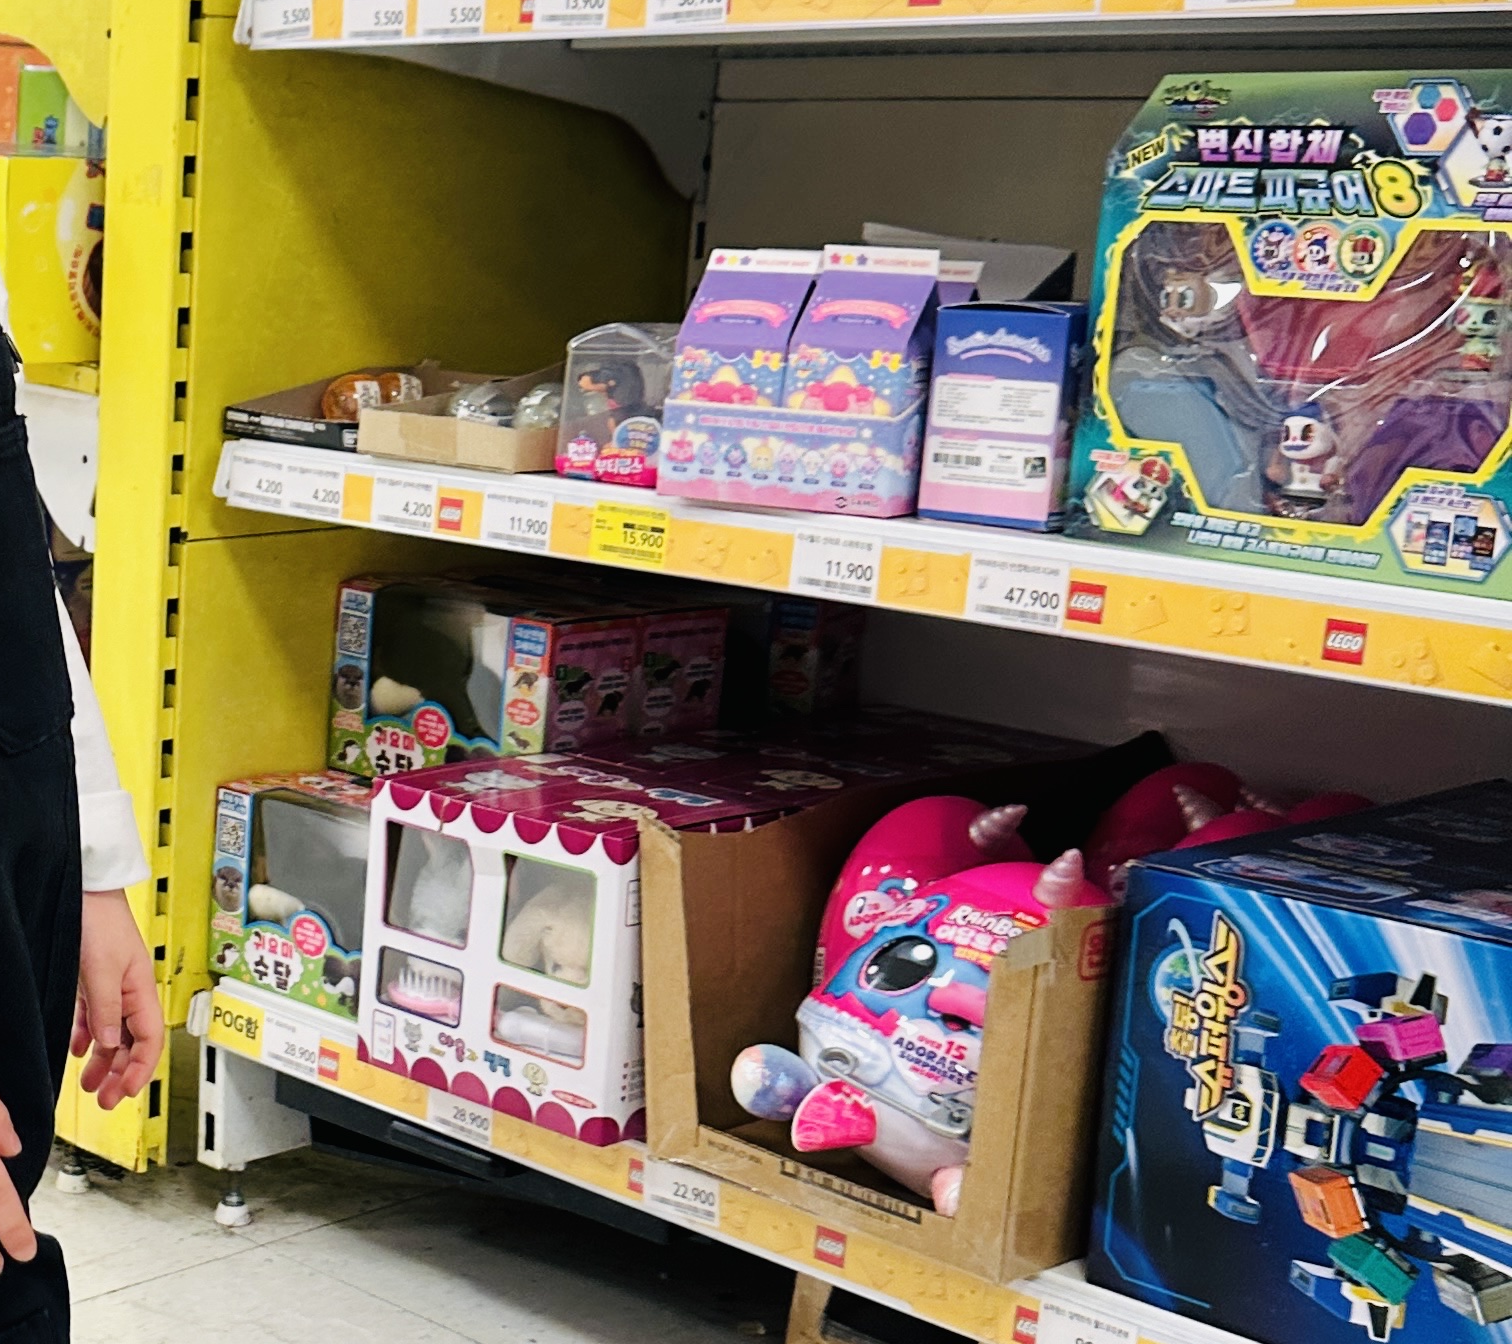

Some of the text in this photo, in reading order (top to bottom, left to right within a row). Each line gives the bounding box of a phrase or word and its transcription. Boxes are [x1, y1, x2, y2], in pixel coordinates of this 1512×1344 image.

[282, 7, 311, 25] 5,500
[373, 9, 404, 27] 5,500
[449, 6, 482, 24] 5,500
[1128, 136, 1167, 169] NEW
[1196, 128, 1345, 164] 변신합체
[1371, 159, 1423, 219] 8
[256, 479, 283, 496] 4,200
[311, 487, 340, 504] 4,200
[402, 501, 433, 519] 4,200
[508, 515, 548, 536] 11,900
[621, 530, 664, 549] 15,900
[824, 559, 874, 583] 11,900
[1004, 586, 1061, 611] 47,900
[1069, 593, 1102, 611] LEGO
[1326, 629, 1364, 651] LEGO
[213, 1006, 260, 1041] POG함
[946, 1040, 969, 1061] 15
[672, 1181, 715, 1207] 22,900
